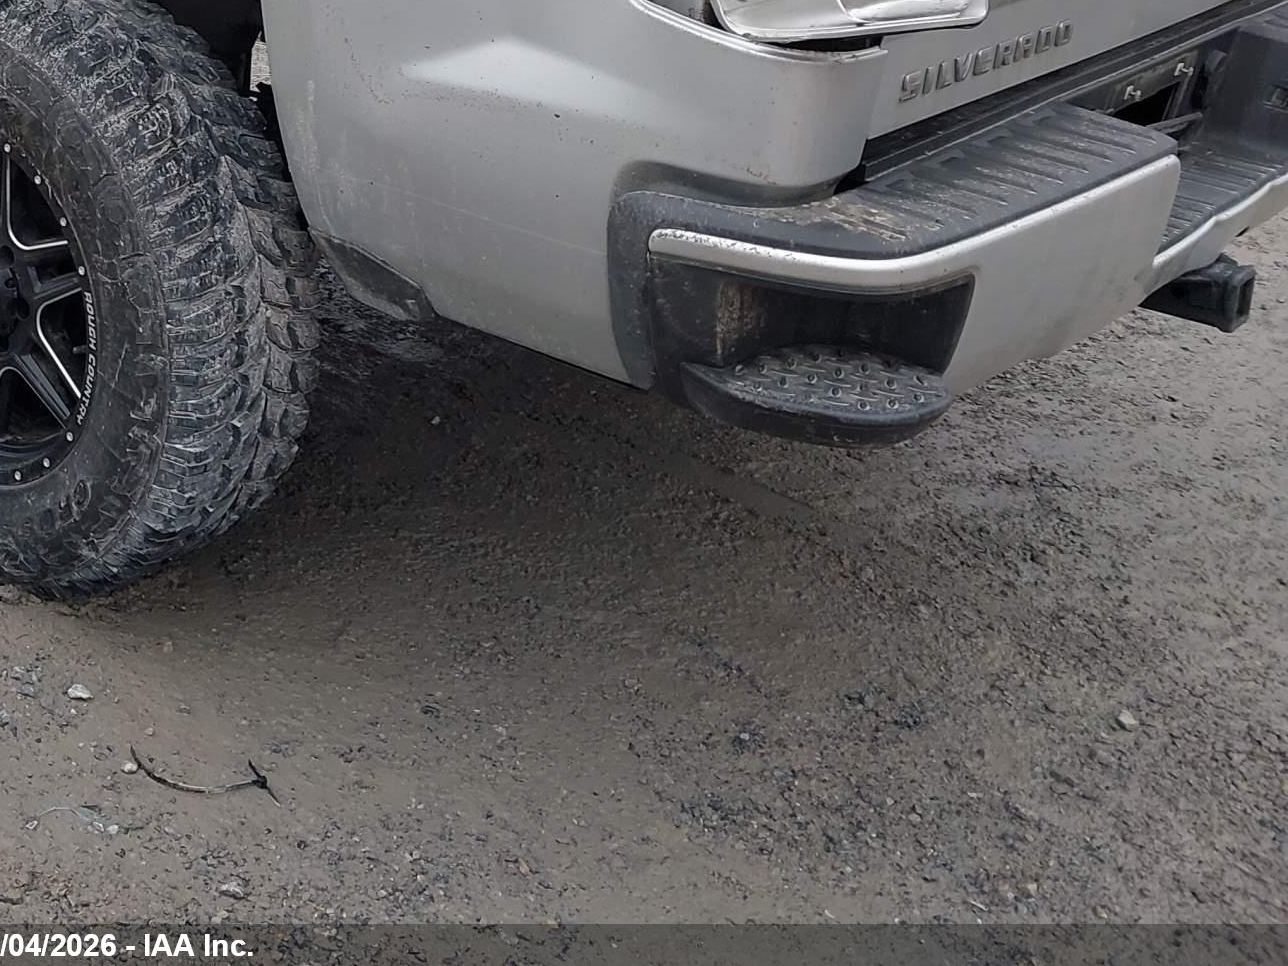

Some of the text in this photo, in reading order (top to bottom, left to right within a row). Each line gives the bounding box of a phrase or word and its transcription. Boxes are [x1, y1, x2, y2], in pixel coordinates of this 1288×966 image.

[899, 19, 1074, 103] SILVERADO
[76, 291, 97, 426] ROUGH COUNTRY
